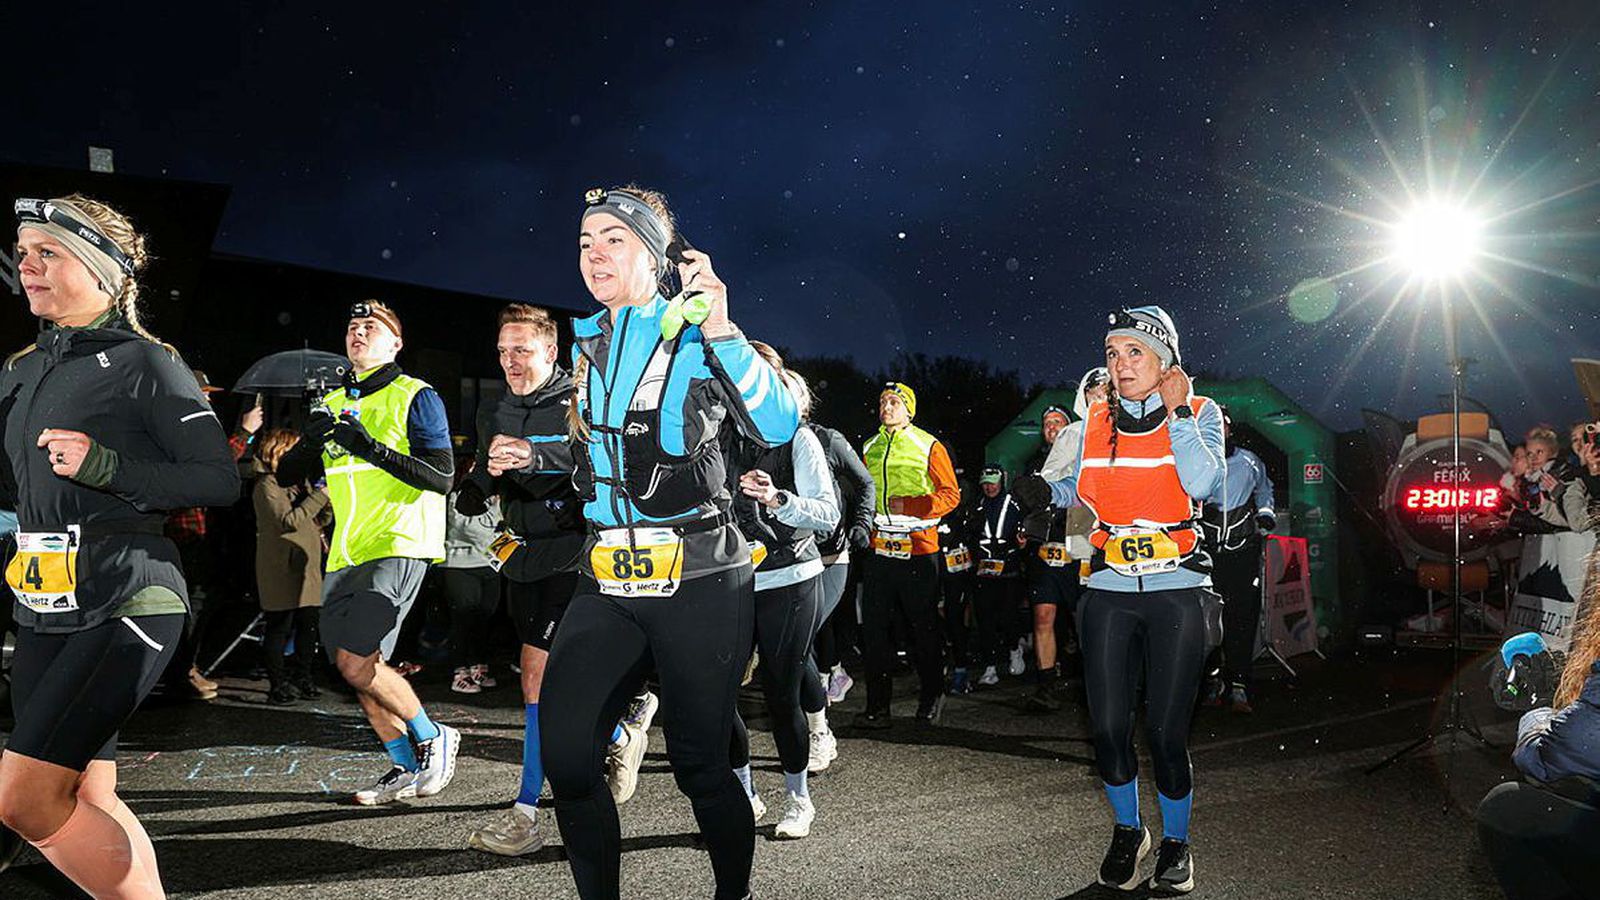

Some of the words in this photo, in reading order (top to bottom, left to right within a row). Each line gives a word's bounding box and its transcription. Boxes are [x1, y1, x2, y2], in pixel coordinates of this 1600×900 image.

[612, 547, 654, 580] 85
[1047, 547, 1062, 560] 53
[1120, 536, 1155, 562] 65
[25, 556, 43, 590] 4
